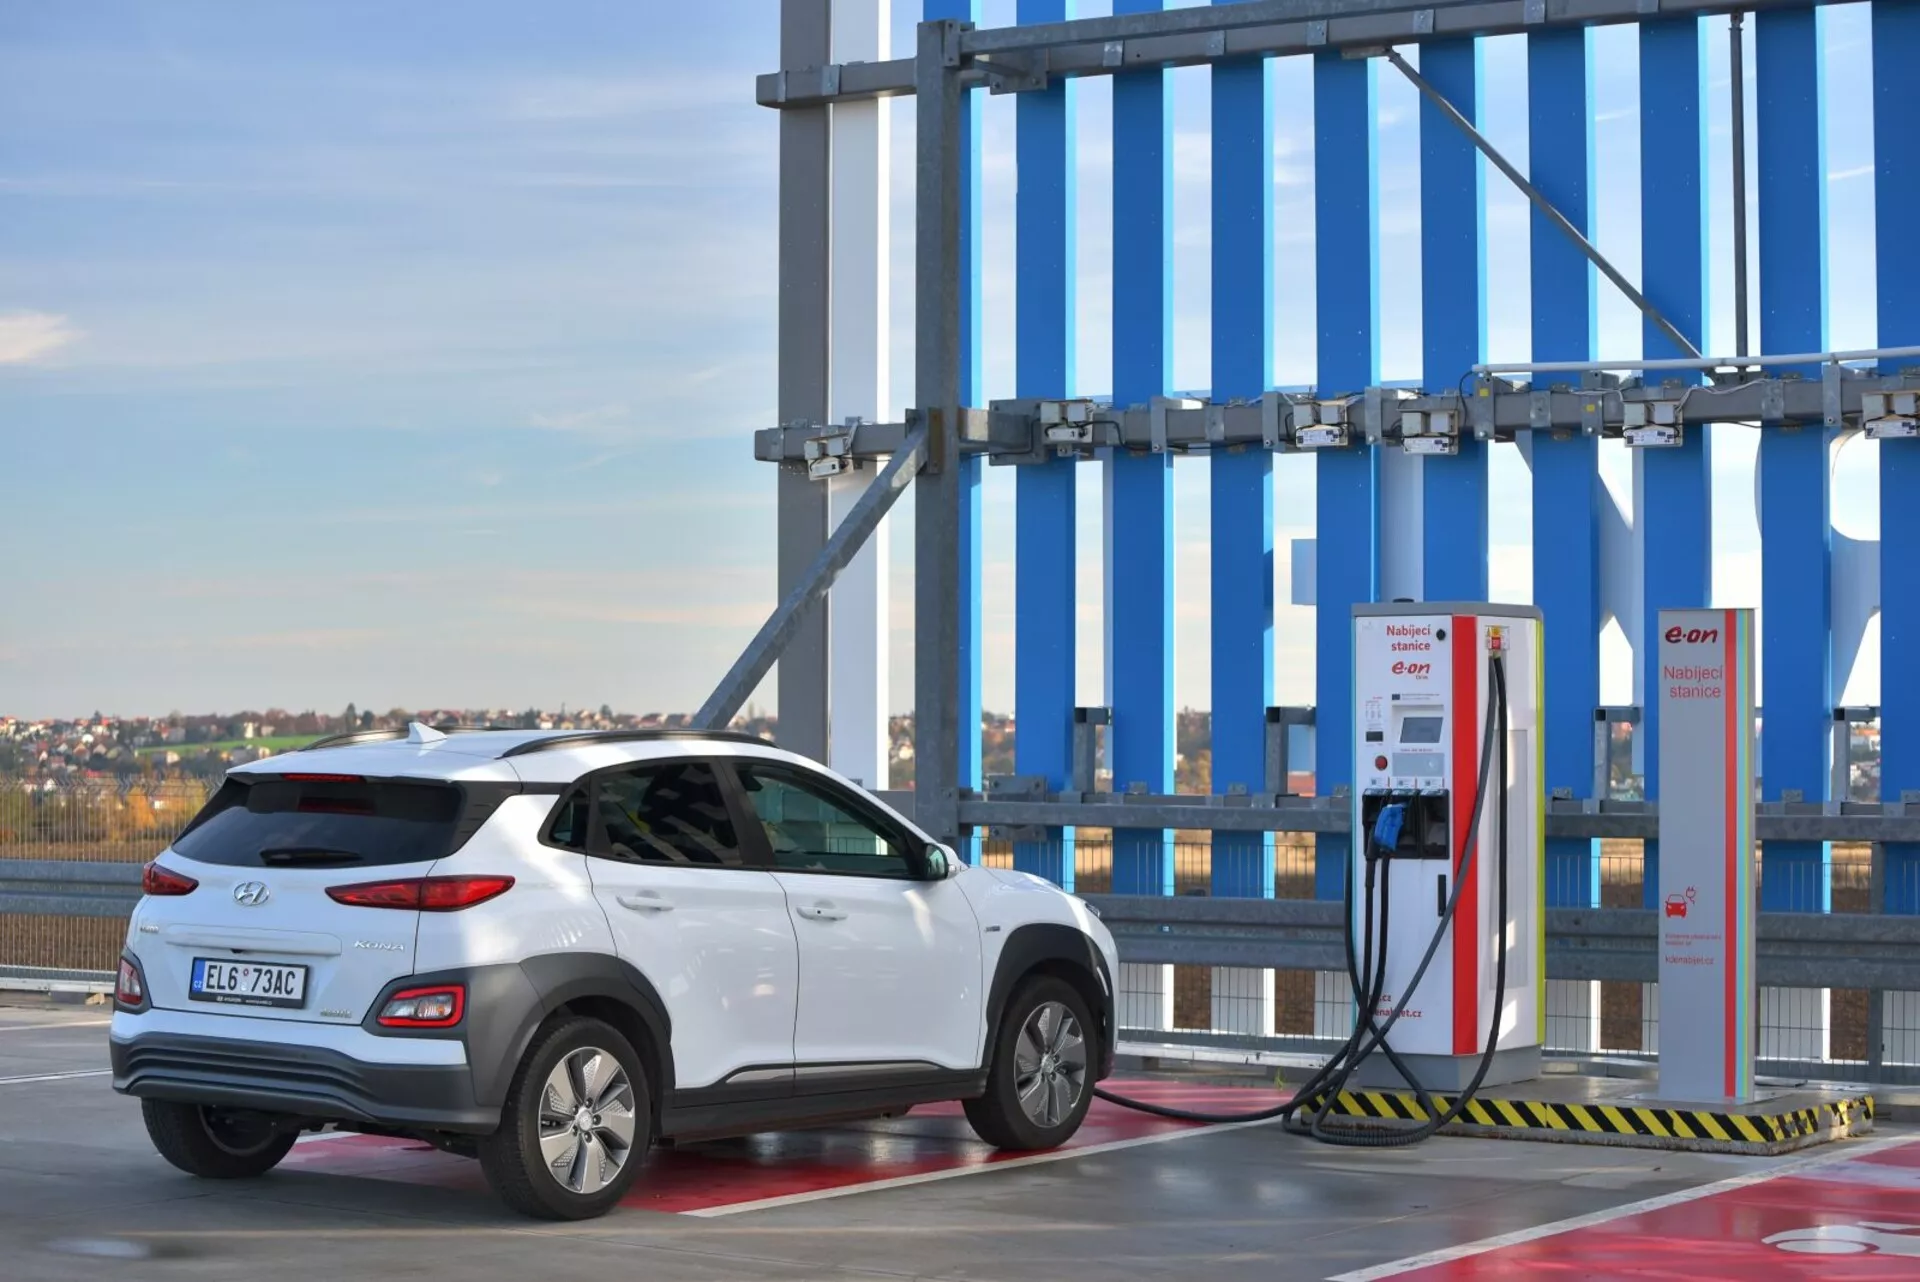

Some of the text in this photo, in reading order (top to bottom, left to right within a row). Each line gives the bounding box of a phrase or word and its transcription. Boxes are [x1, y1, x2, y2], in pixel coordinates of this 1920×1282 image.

[1387, 623, 1431, 638] Nabíjecí
[1391, 640, 1431, 651] stanice
[1669, 684, 1721, 698] stanice
[354, 940, 404, 952] KONA
[194, 980, 202, 988] CZ
[206, 964, 296, 995] EL6 73AC
